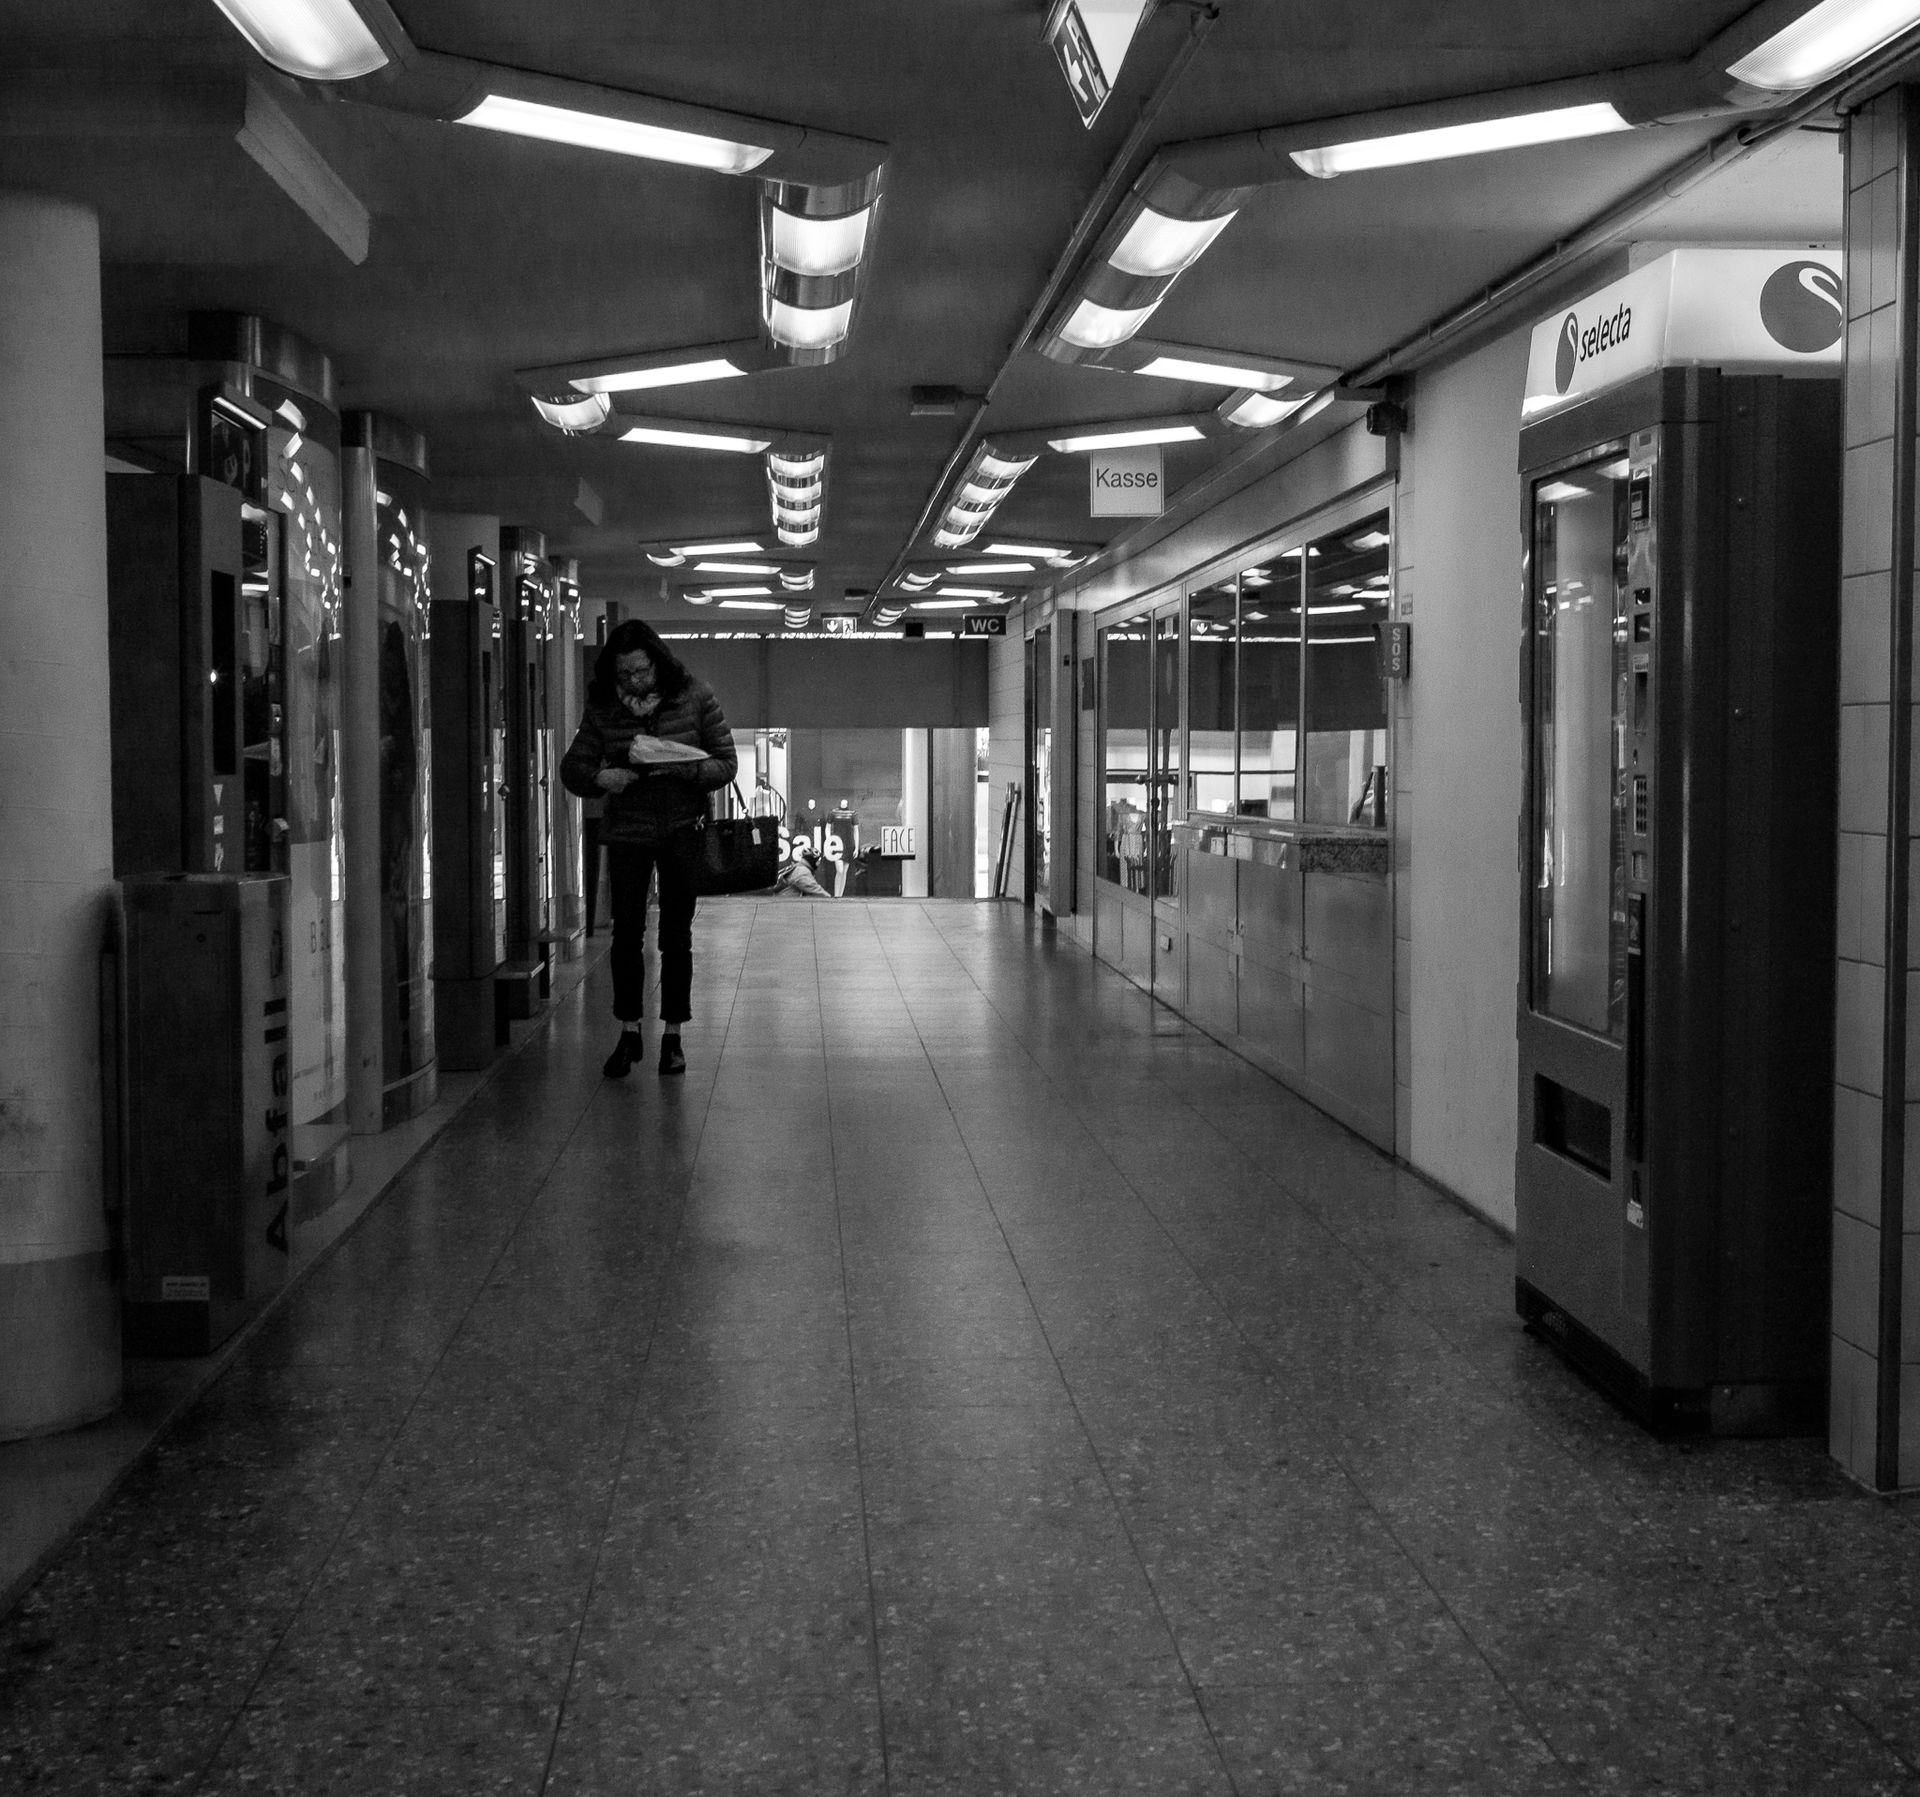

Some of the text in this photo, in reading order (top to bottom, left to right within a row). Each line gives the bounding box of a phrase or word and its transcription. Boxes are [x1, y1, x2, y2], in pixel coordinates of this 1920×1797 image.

[1579, 302, 1631, 362] selecta
[1096, 467, 1158, 488] Kasse
[971, 618, 1000, 633] WC
[1391, 627, 1401, 672] SOS
[882, 828, 915, 854] FACE
[264, 998, 289, 1254] Abfall
